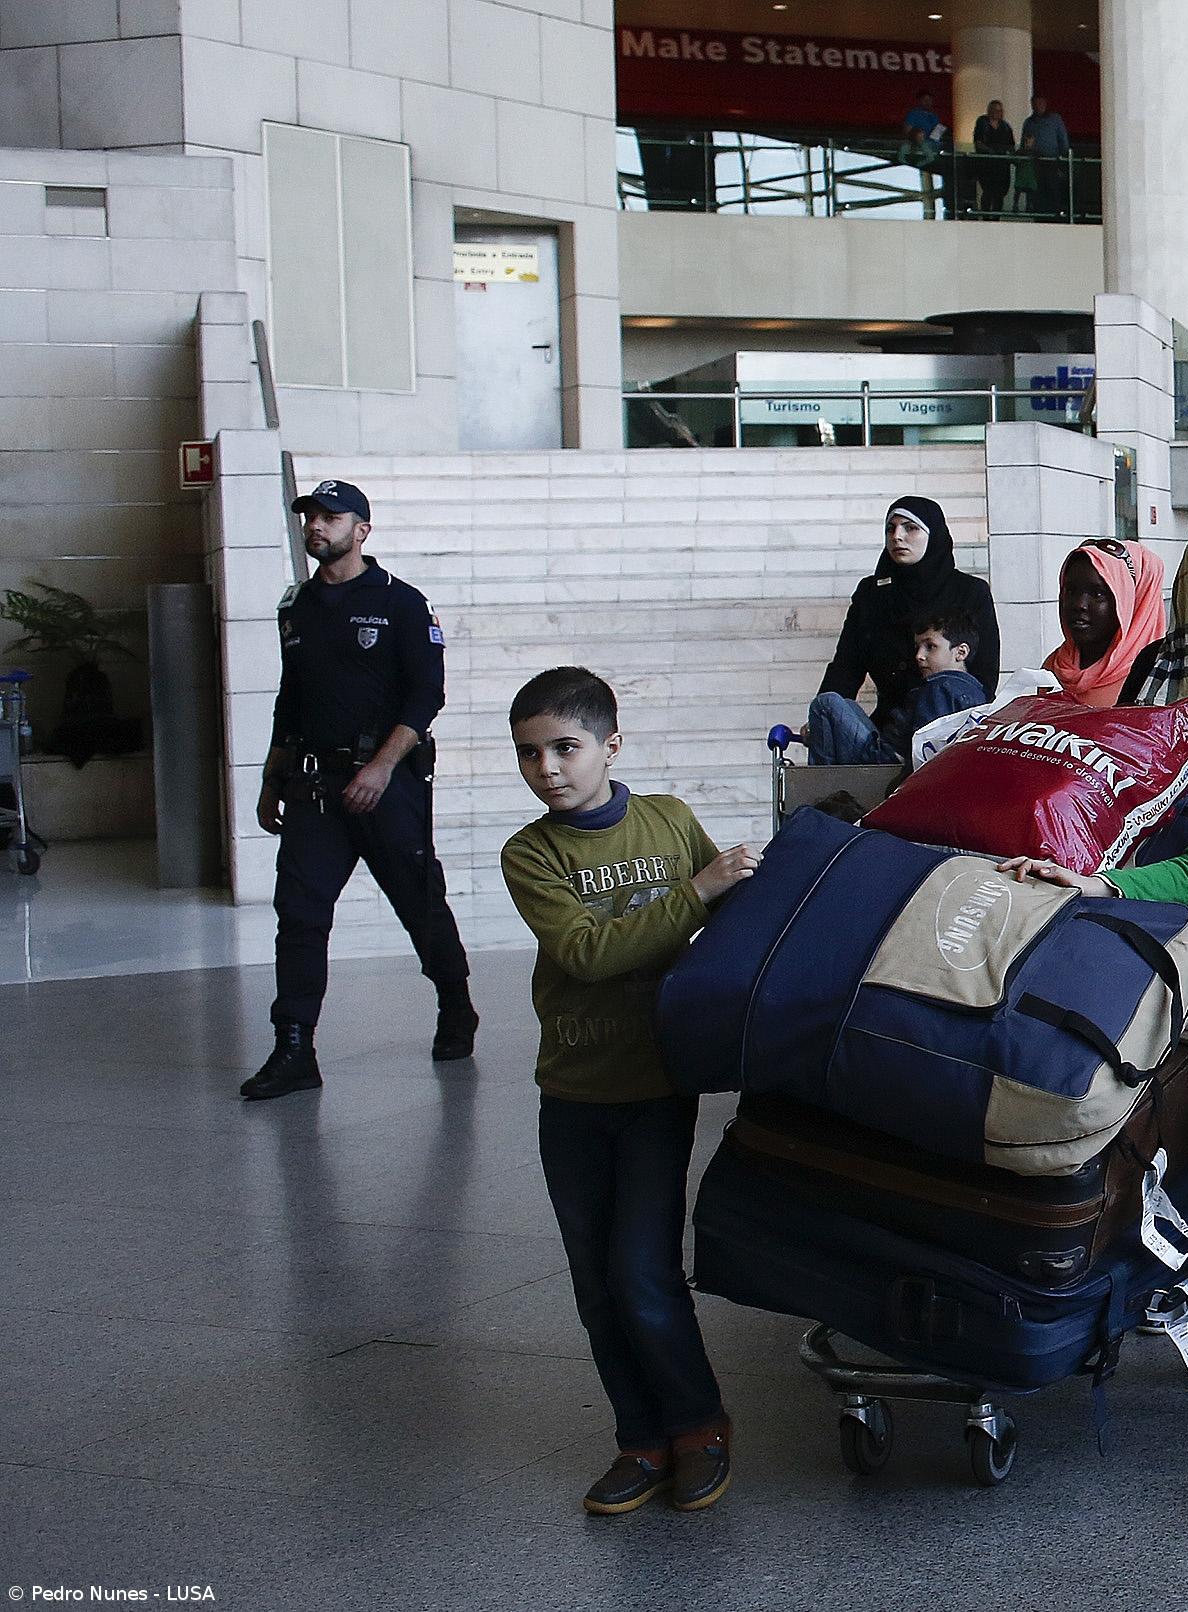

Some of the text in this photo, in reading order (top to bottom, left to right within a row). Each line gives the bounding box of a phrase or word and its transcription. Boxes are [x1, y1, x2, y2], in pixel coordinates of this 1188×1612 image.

[620, 29, 952, 75] Make Statements
[765, 401, 952, 416] Turismo Viagens
[349, 614, 390, 626] POLÍCIA
[976, 744, 1019, 757] everyone
[1020, 749, 1062, 766] deserves
[1063, 760, 1074, 769] to
[1098, 786, 1115, 809] well
[563, 854, 682, 896] RBERRY
[938, 879, 1009, 954] SAMSUNG
